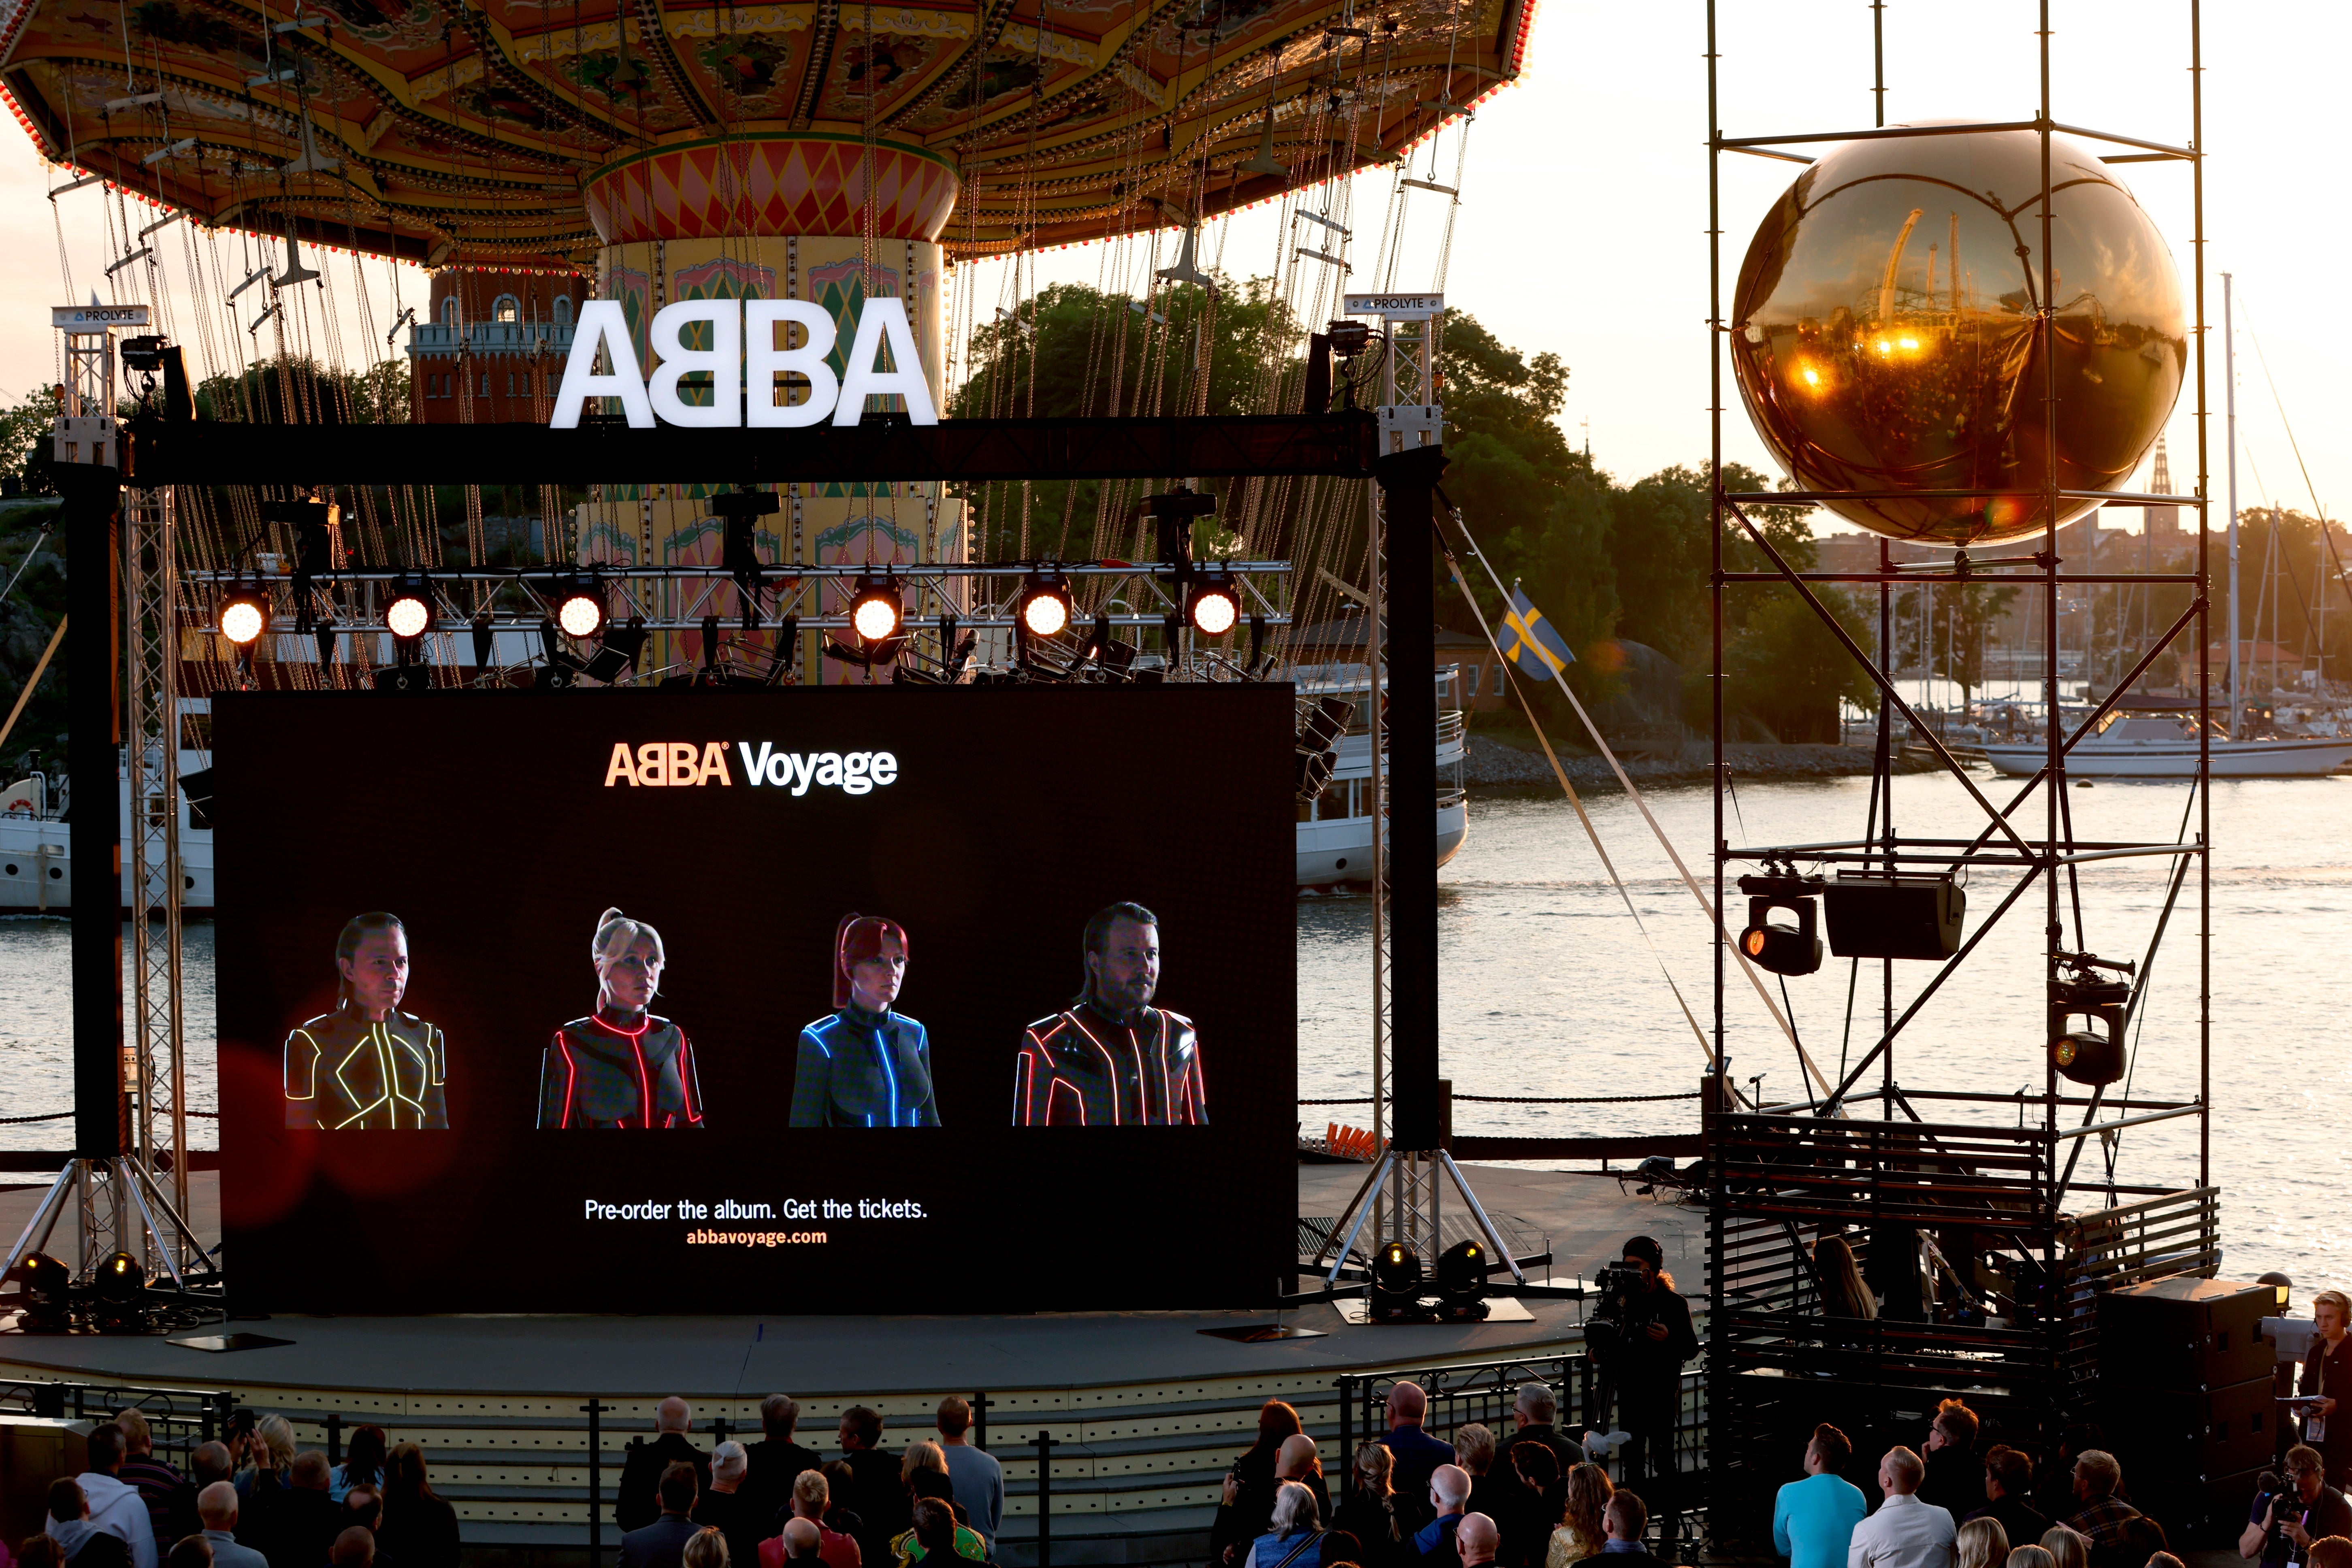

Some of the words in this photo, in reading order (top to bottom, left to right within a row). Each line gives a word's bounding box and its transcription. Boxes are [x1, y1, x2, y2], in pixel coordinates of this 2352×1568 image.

[1374, 298, 1423, 309] PROLYTE
[86, 309, 134, 321] PROLYTE
[550, 297, 939, 428] ABBA
[738, 741, 897, 797] Voyage
[586, 1199, 672, 1220] Pre-order
[677, 1199, 707, 1220] the
[714, 1199, 776, 1219] album.
[783, 1198, 817, 1219] Get
[822, 1198, 852, 1219] the
[858, 1198, 927, 1219] tickets.
[686, 1229, 827, 1248] abbavoyage.com
